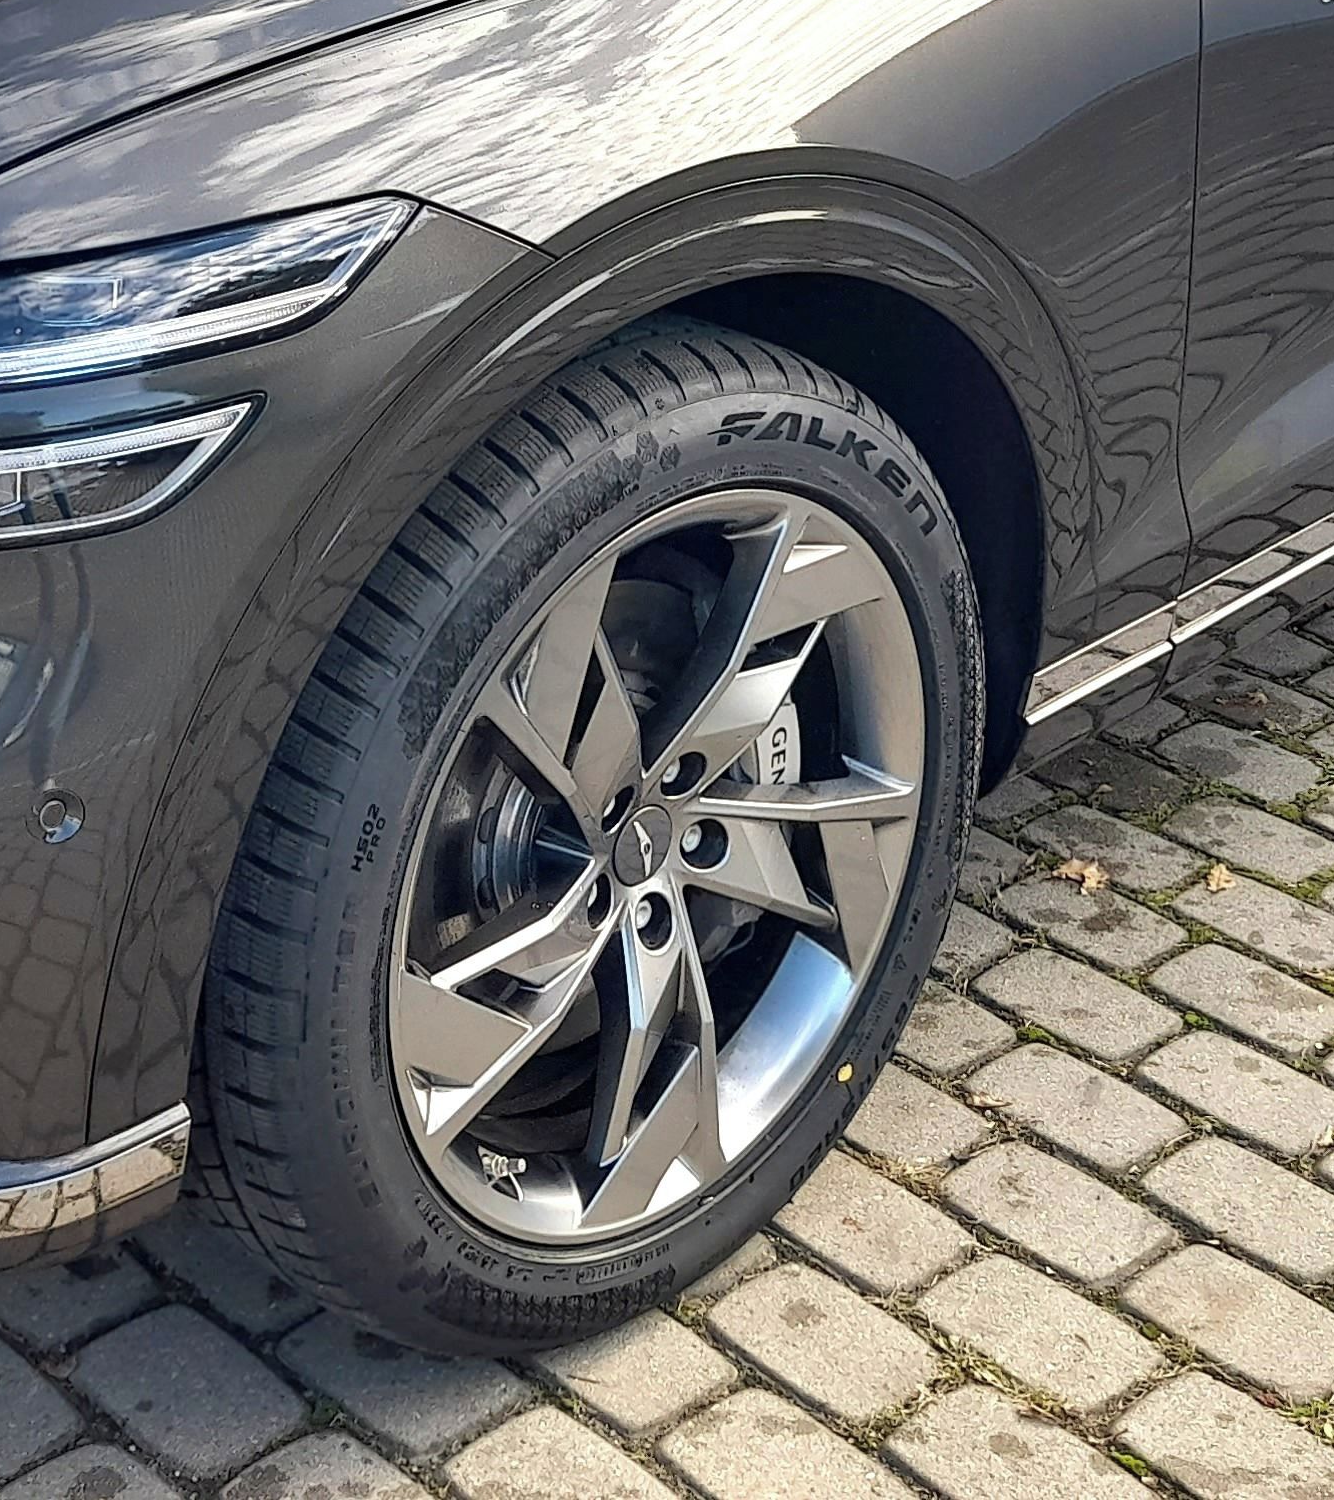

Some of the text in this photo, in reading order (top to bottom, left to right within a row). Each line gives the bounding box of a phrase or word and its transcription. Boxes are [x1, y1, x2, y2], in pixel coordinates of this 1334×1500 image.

[707, 411, 940, 538] FALKEN
[350, 802, 381, 873] HS02
[365, 816, 387, 864] PRO
